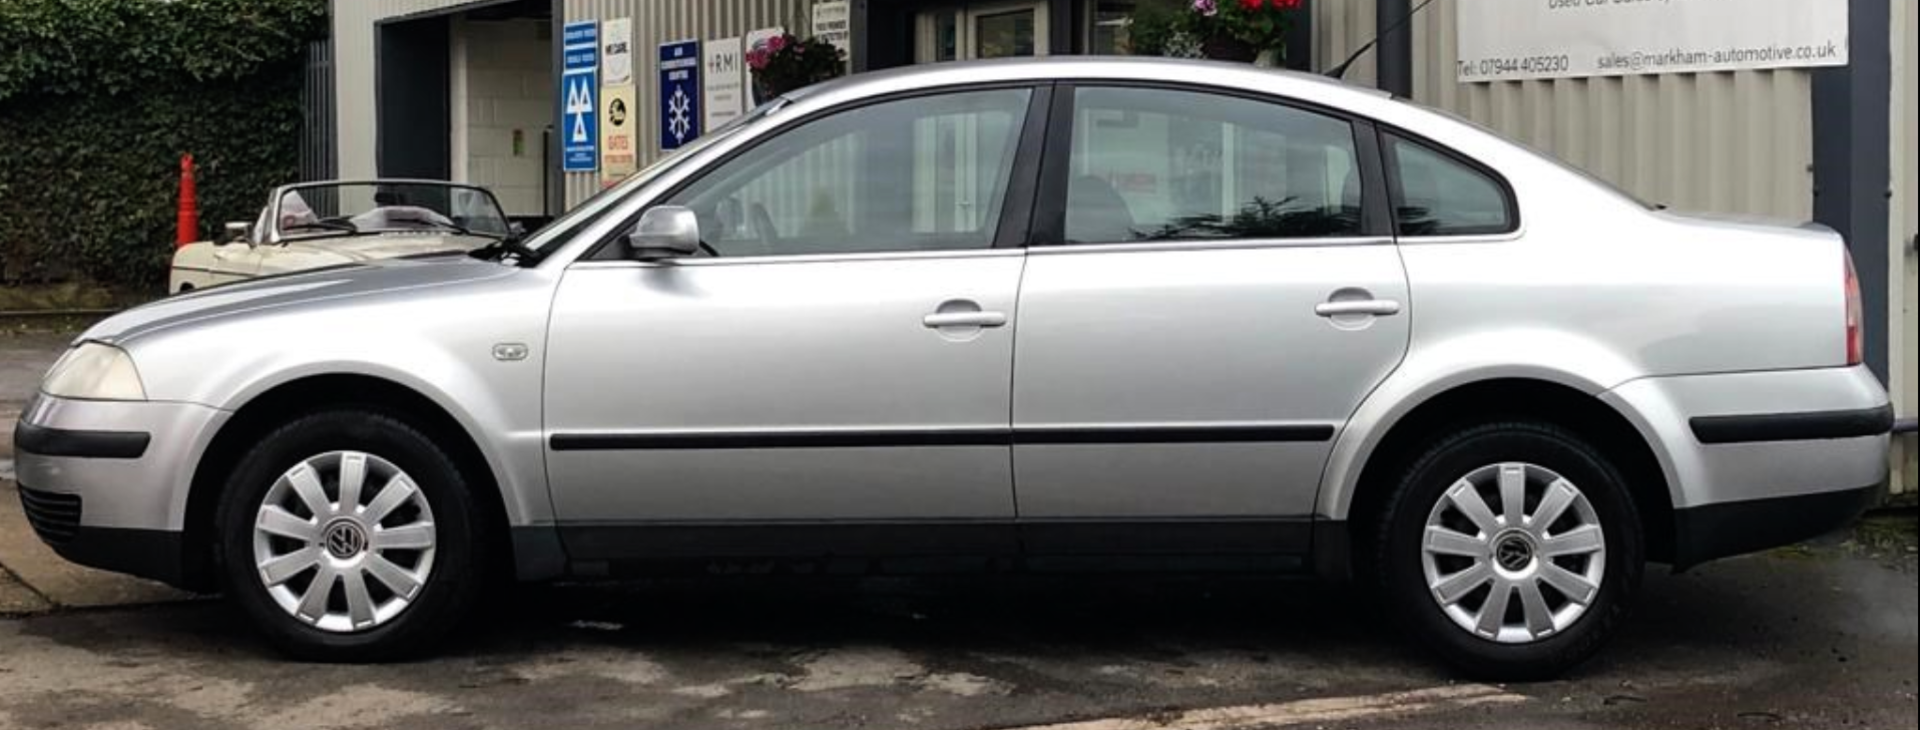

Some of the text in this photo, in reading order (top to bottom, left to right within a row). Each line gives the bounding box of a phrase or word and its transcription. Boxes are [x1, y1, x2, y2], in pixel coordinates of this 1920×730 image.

[1457, 39, 1837, 76] Tel: 07944 405230 sales@markham-automotive.co.uk
